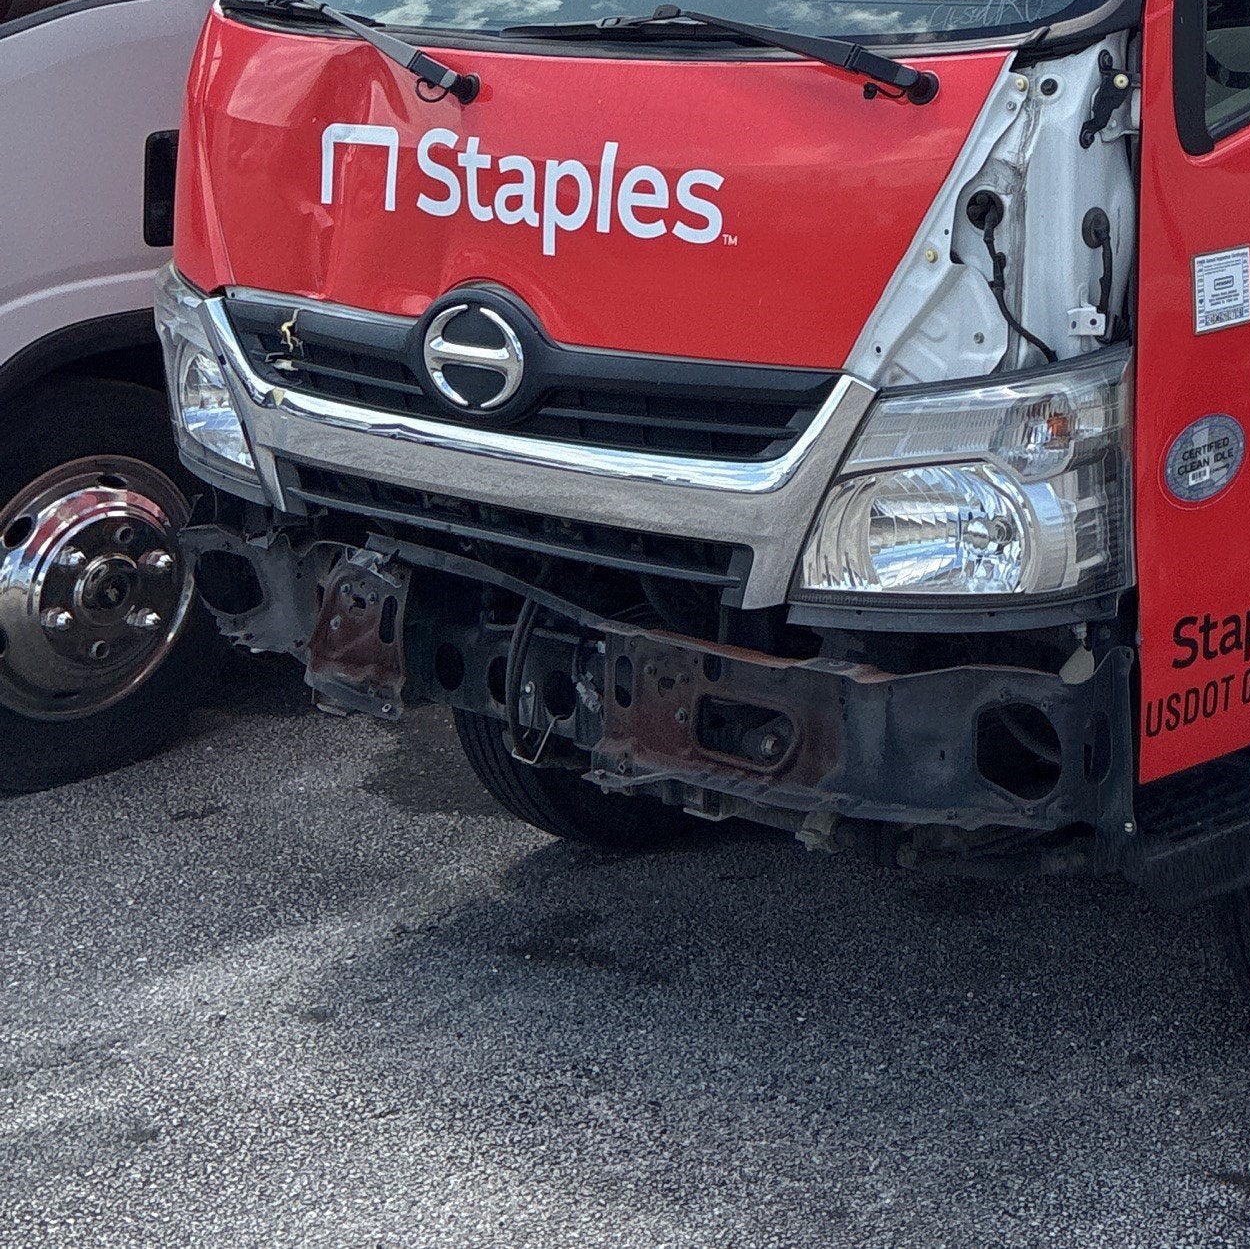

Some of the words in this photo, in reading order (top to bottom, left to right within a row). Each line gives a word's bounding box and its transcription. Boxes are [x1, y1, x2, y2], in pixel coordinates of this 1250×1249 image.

[416, 127, 725, 256] Staples
[1177, 456, 1210, 476] CLEAN
[1213, 447, 1234, 463] IDLE
[1182, 436, 1230, 462] CERTIFIED
[1145, 674, 1235, 737] USDOT
